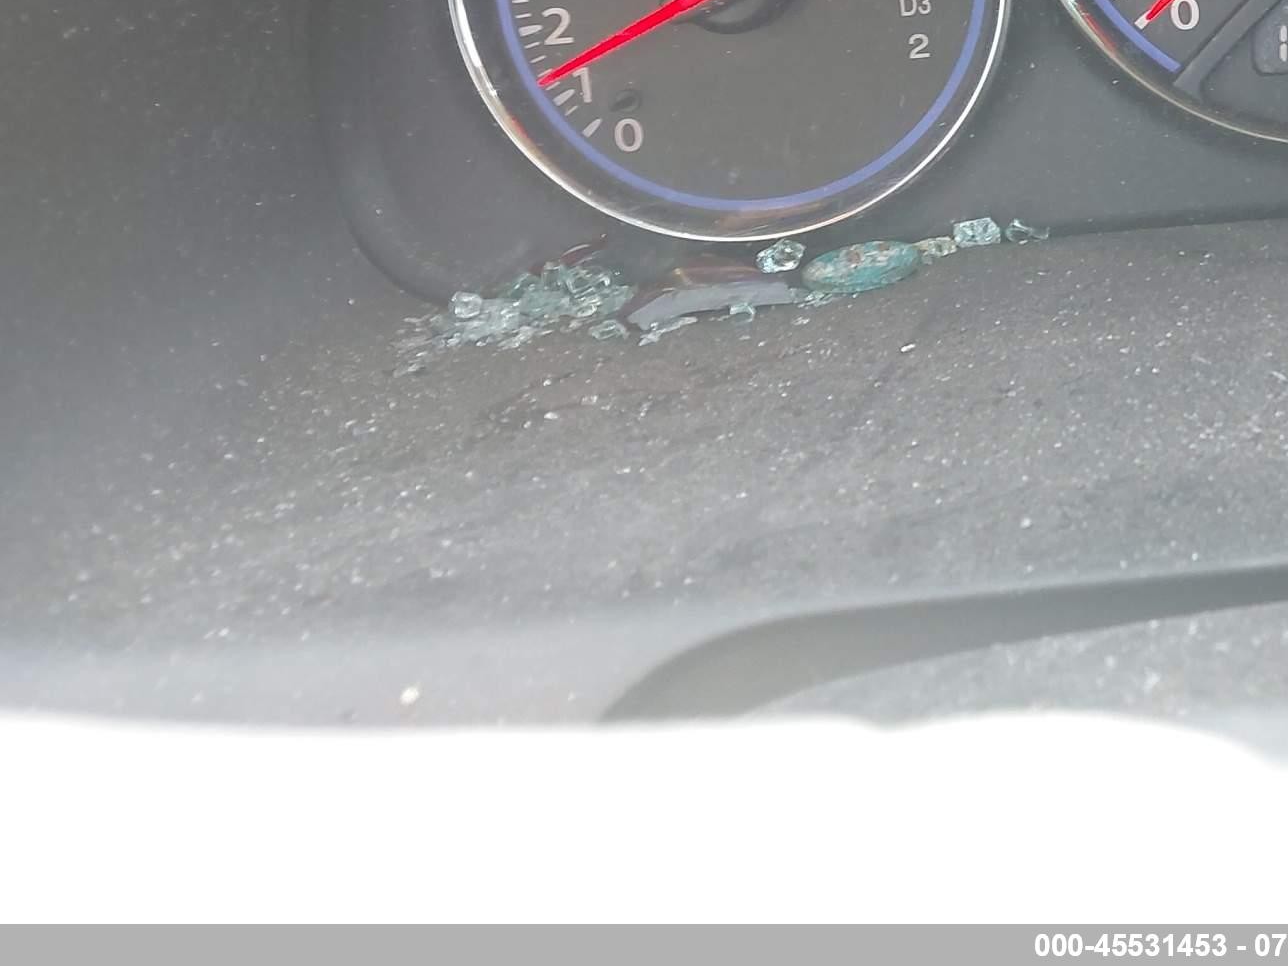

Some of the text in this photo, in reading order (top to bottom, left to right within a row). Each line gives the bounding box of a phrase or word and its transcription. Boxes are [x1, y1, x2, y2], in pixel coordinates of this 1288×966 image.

[543, 7, 574, 45] 2
[908, 33, 931, 59] 2
[569, 67, 593, 102] 1
[614, 119, 643, 153] 0
